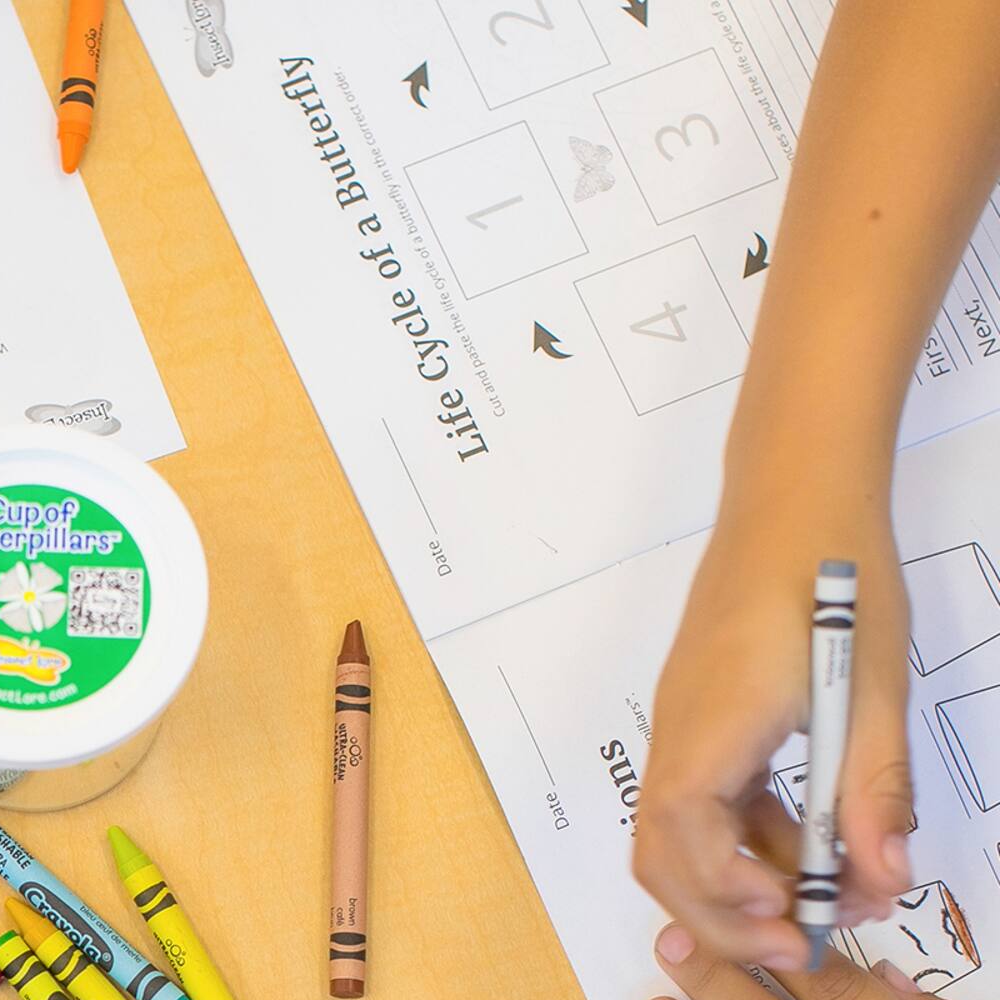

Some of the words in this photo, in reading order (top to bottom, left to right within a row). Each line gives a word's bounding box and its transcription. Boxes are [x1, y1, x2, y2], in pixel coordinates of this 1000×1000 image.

[712, 11, 727, 23] of
[723, 25, 743, 53] cycle
[737, 56, 753, 75] life
[748, 77, 763, 96] the
[350, 103, 376, 146] correct
[758, 97, 782, 132] about
[279, 56, 369, 210] Butterfly
[653, 112, 720, 162] 3
[371, 148, 384, 167] the
[383, 169, 393, 182] in
[357, 213, 382, 236] a
[387, 183, 418, 235] butterfly
[466, 194, 523, 231] 1
[360, 243, 402, 280] of
[414, 246, 430, 259] of
[425, 262, 447, 290] cycle
[440, 292, 453, 312] life
[392, 288, 449, 381] Cycle
[450, 312, 467, 334] the
[629, 301, 688, 343] 4
[964, 299, 1000, 358] Next,
[461, 335, 484, 367] paste
[924, 337, 951, 378] Firs
[475, 369, 495, 393] and
[488, 394, 506, 417] Cut
[437, 388, 489, 462] Life
[45, 501, 76, 523] of
[428, 540, 452, 577] Date
[546, 791, 570, 830] Date
[26, 888, 100, 963] Crayola
[348, 897, 358, 926] brown
[80, 905, 97, 922] bleu
[111, 932, 123, 946] de
[121, 942, 142, 964] merle
